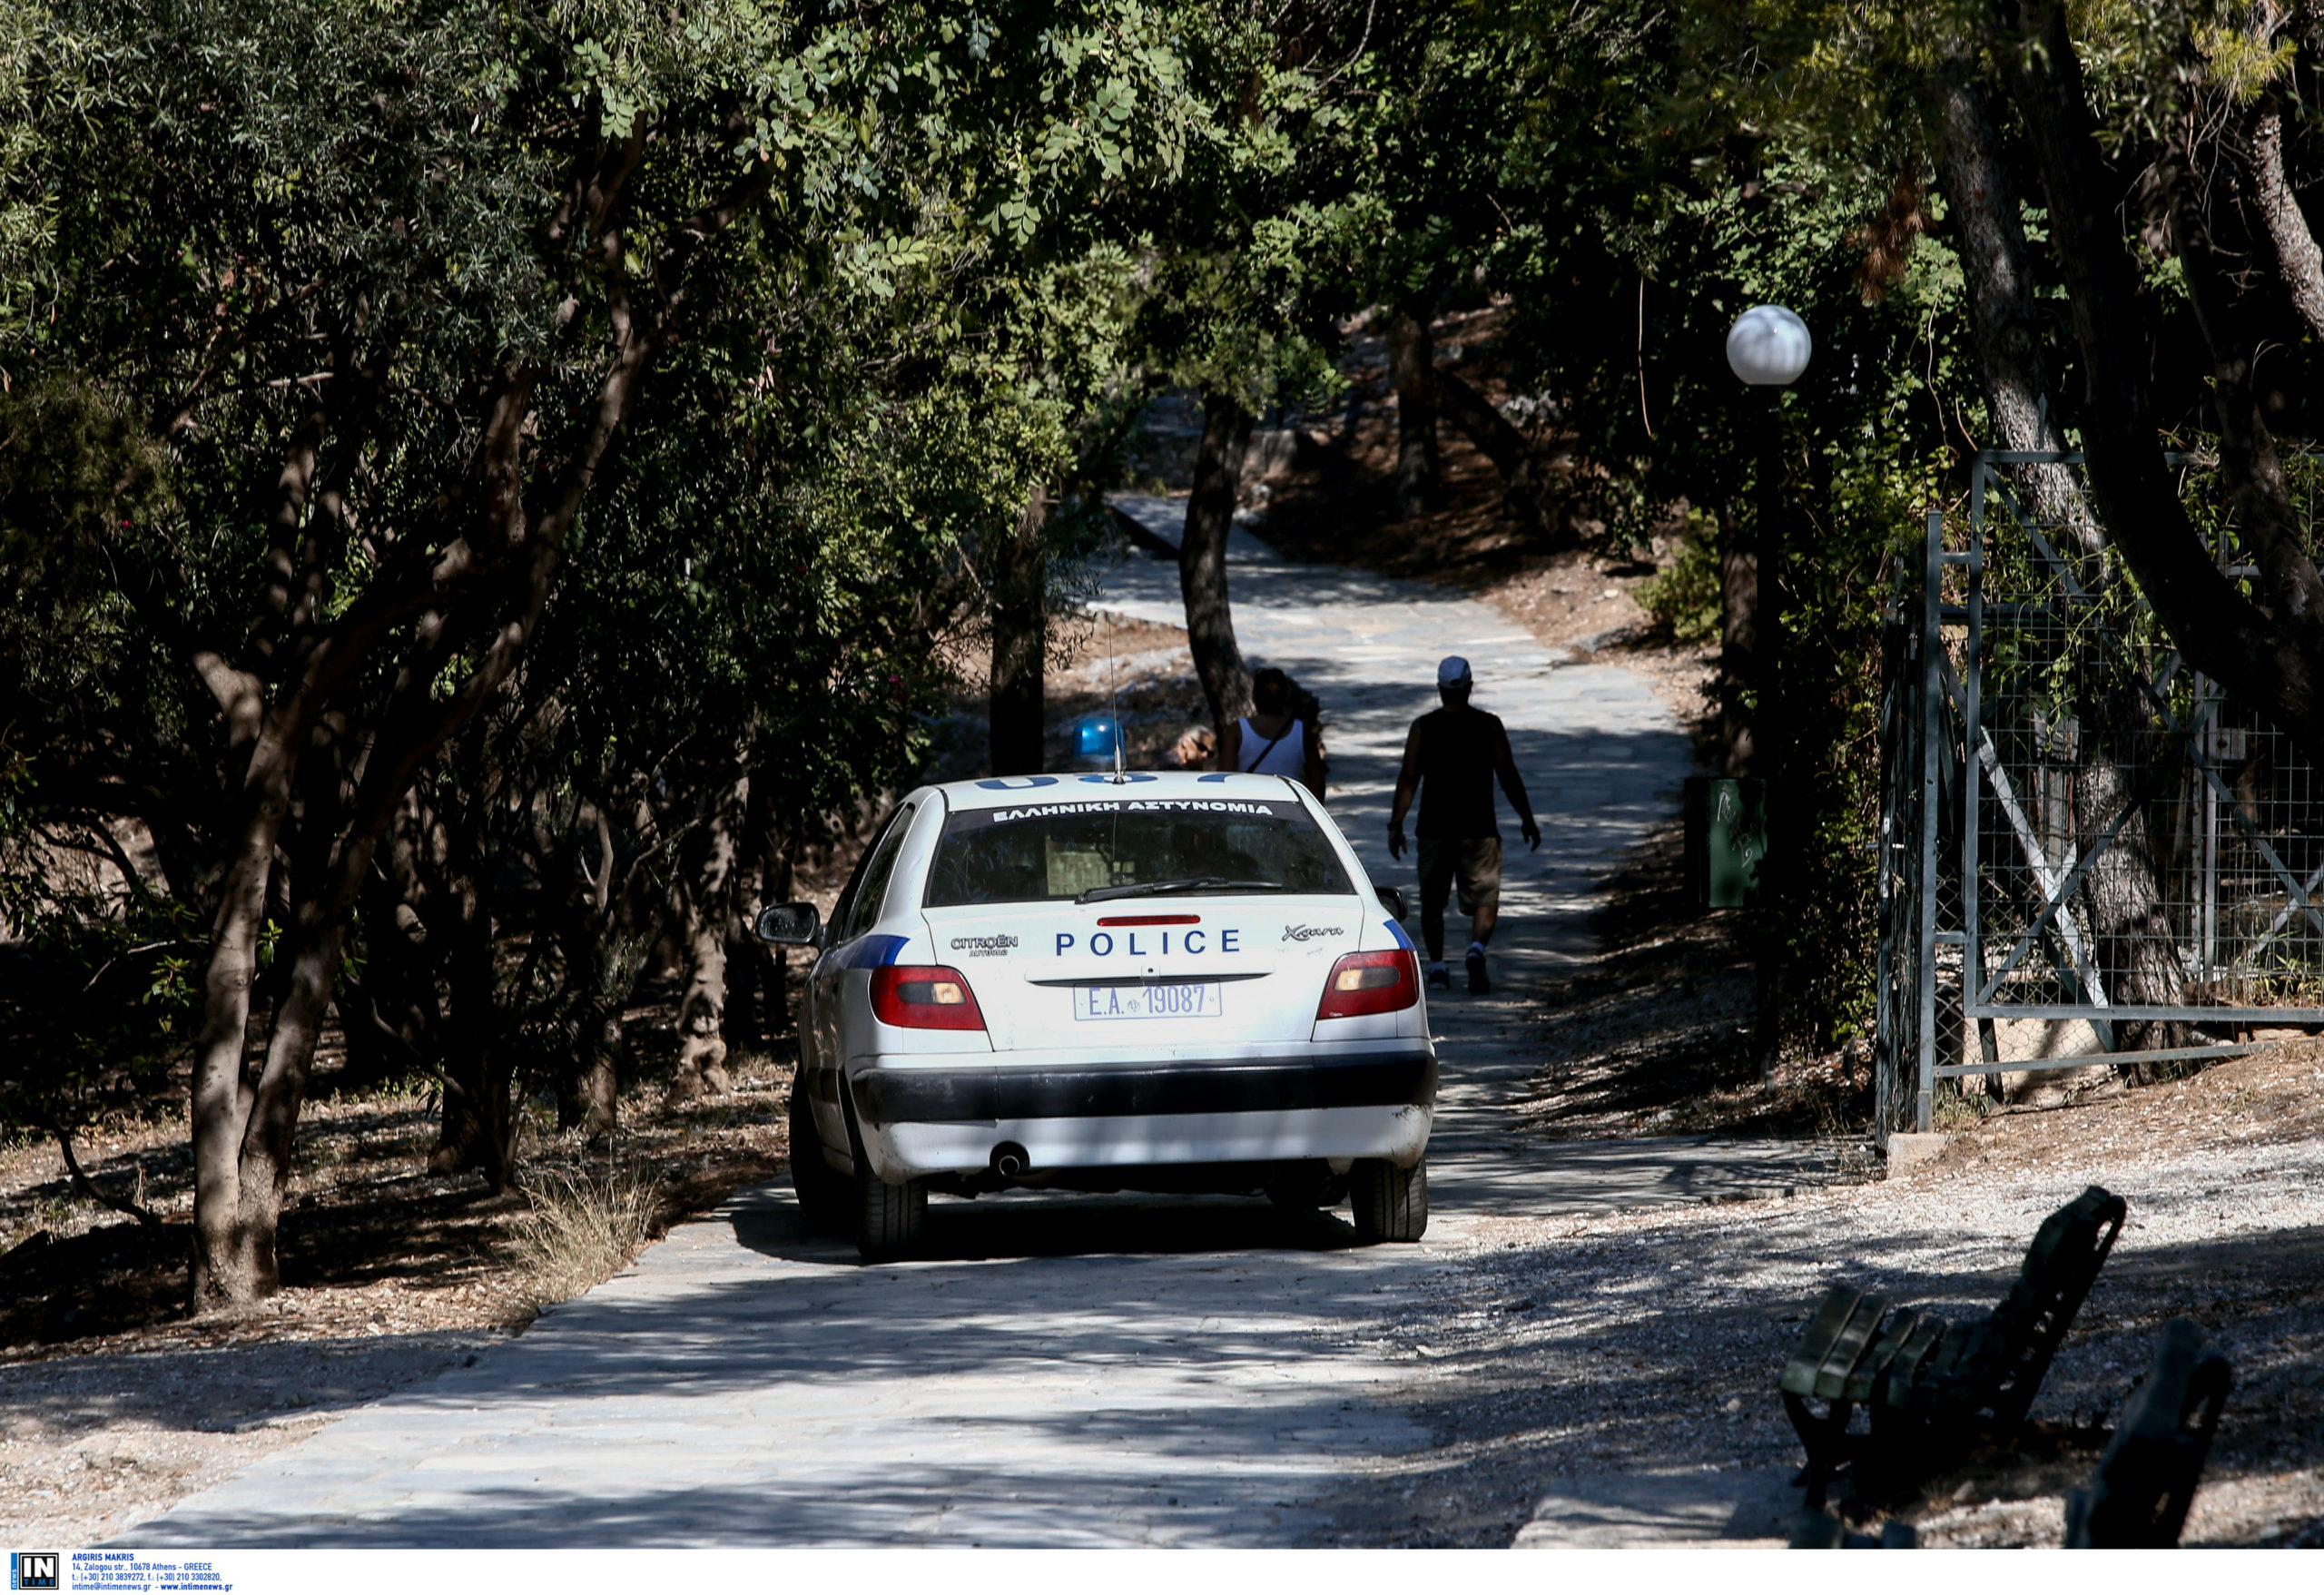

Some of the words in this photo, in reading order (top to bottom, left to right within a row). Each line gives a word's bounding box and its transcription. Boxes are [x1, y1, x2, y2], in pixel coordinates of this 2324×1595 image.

[992, 802, 1120, 822] ΕΛΛΗΝΙΚΗ
[1128, 801, 1273, 816] ΑΣΤΥΝΟΜΙΑ
[950, 933, 1019, 950] CITROËN
[1282, 923, 1344, 941] Xsara
[1056, 930, 1240, 956] POLICE
[1142, 984, 1206, 1013] 19087
